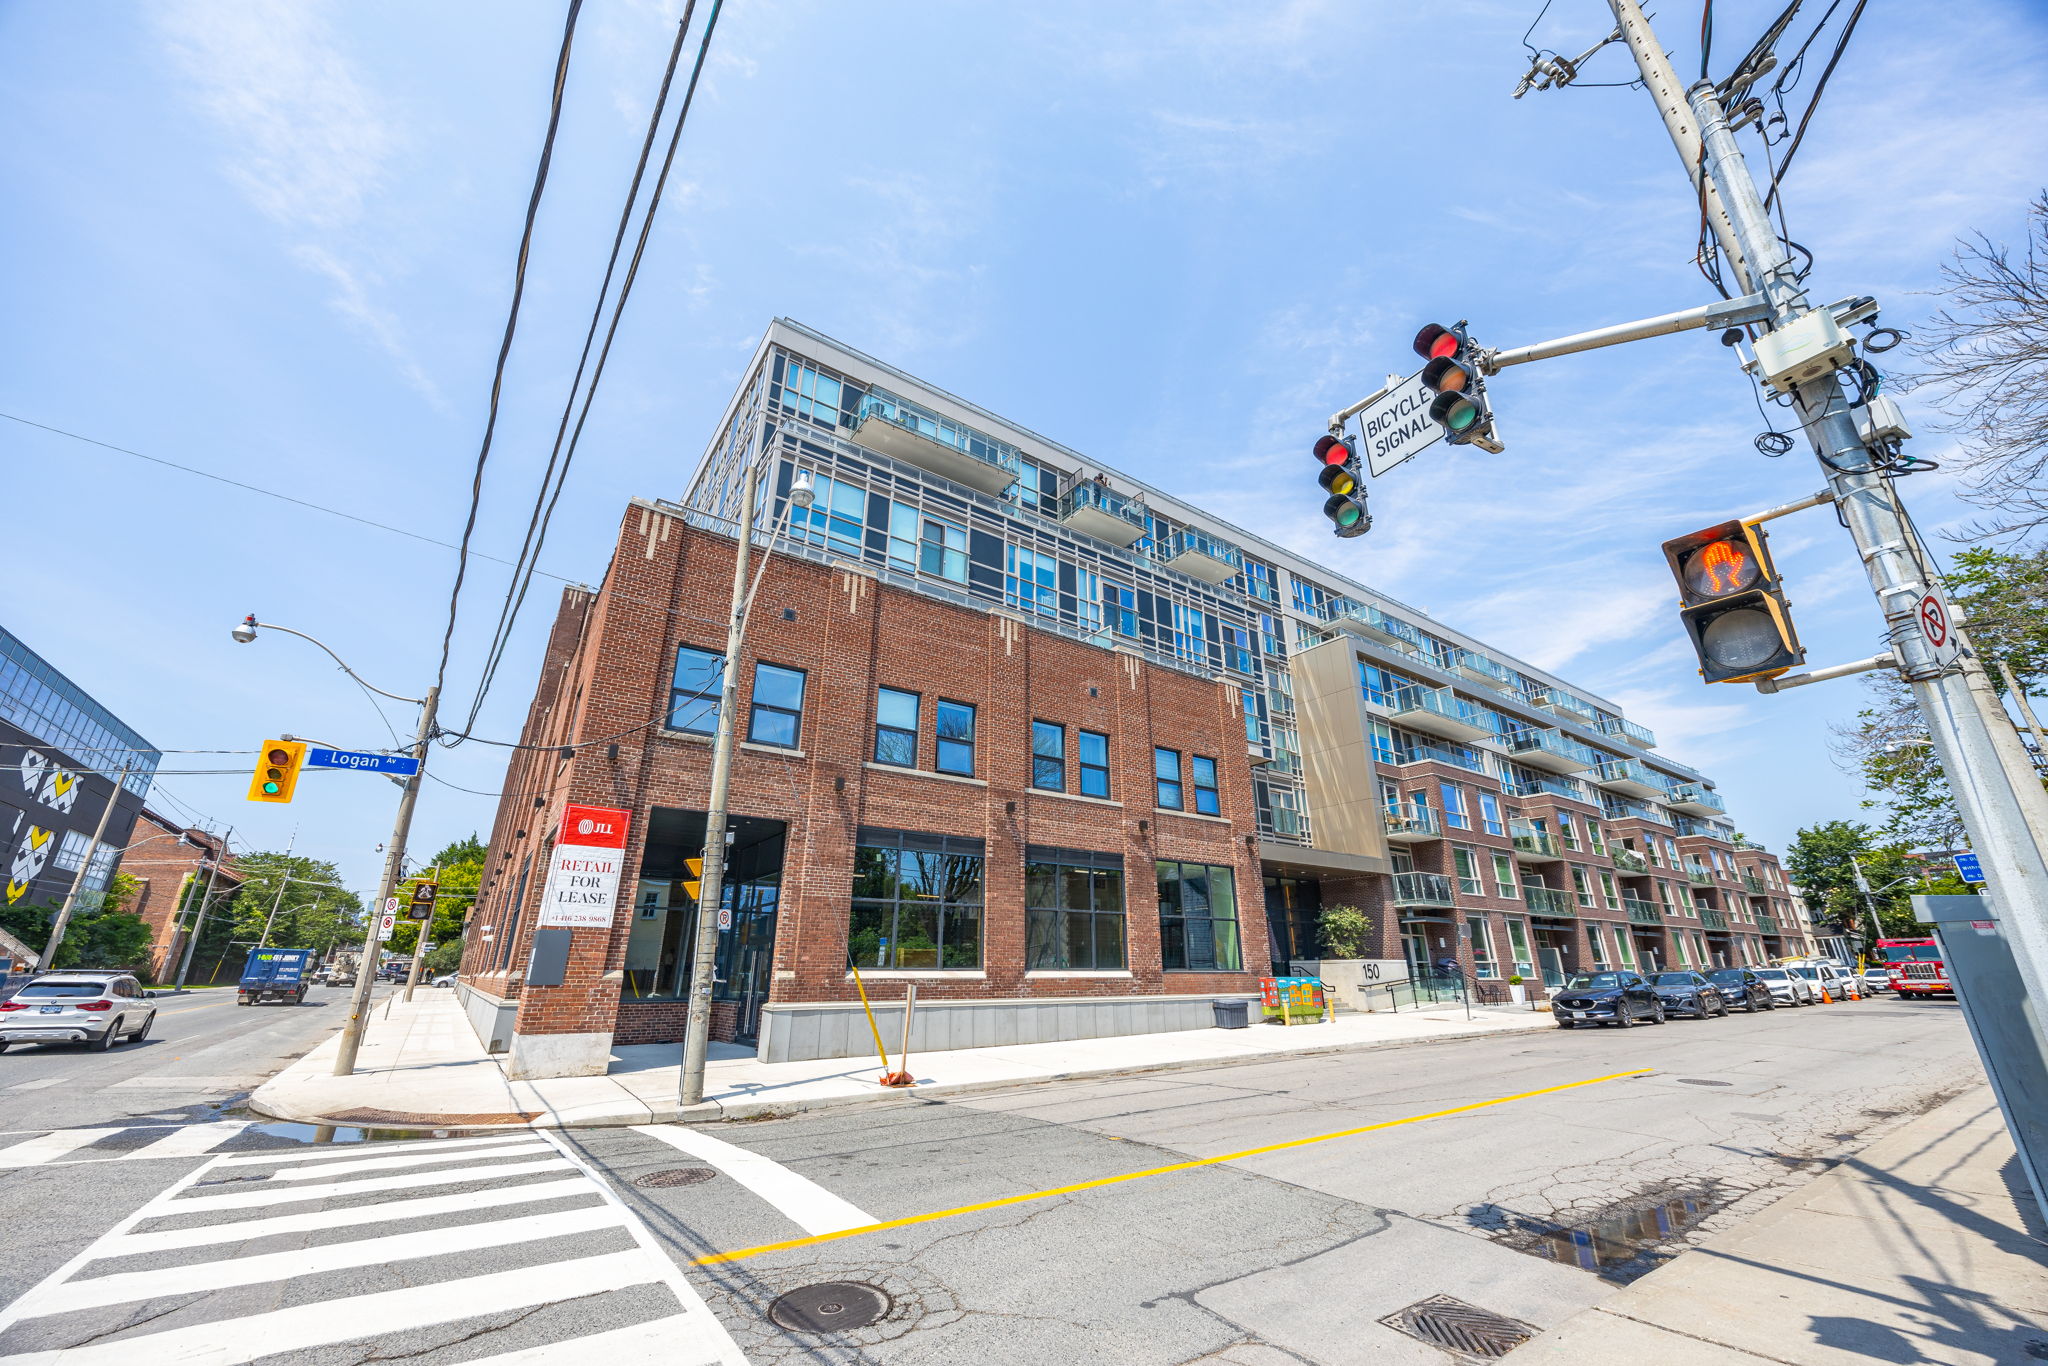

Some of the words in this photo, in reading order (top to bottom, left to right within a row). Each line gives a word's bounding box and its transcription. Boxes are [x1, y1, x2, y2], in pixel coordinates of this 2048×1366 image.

[1367, 385, 1431, 438] BICYCLE
[1376, 414, 1433, 457] SIGNAL
[331, 752, 380, 768] Logan
[593, 823, 614, 834] JLL
[561, 859, 616, 874] RETAIL
[570, 875, 600, 888] FOR
[558, 891, 607, 905] LEASE
[1362, 963, 1380, 979] 150
